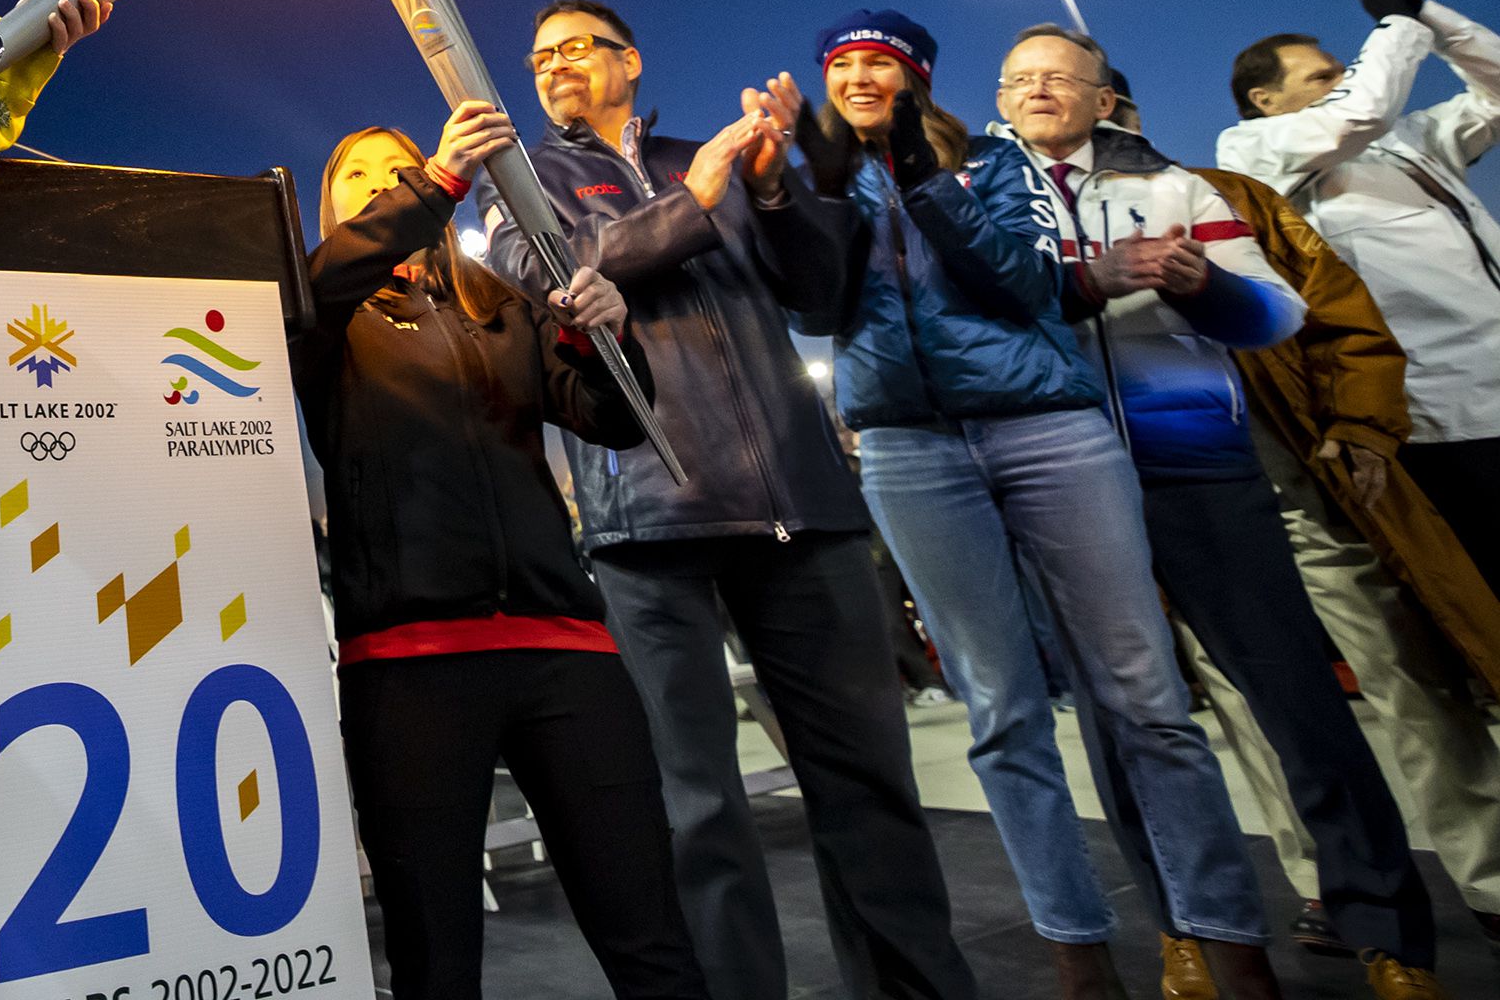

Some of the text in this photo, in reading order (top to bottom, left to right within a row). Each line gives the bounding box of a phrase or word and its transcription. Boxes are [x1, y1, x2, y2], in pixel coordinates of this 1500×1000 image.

[24, 402, 69, 419] LAKE
[165, 420, 272, 437] SALT LAKE 2002
[167, 438, 275, 457] PARALYMPICS
